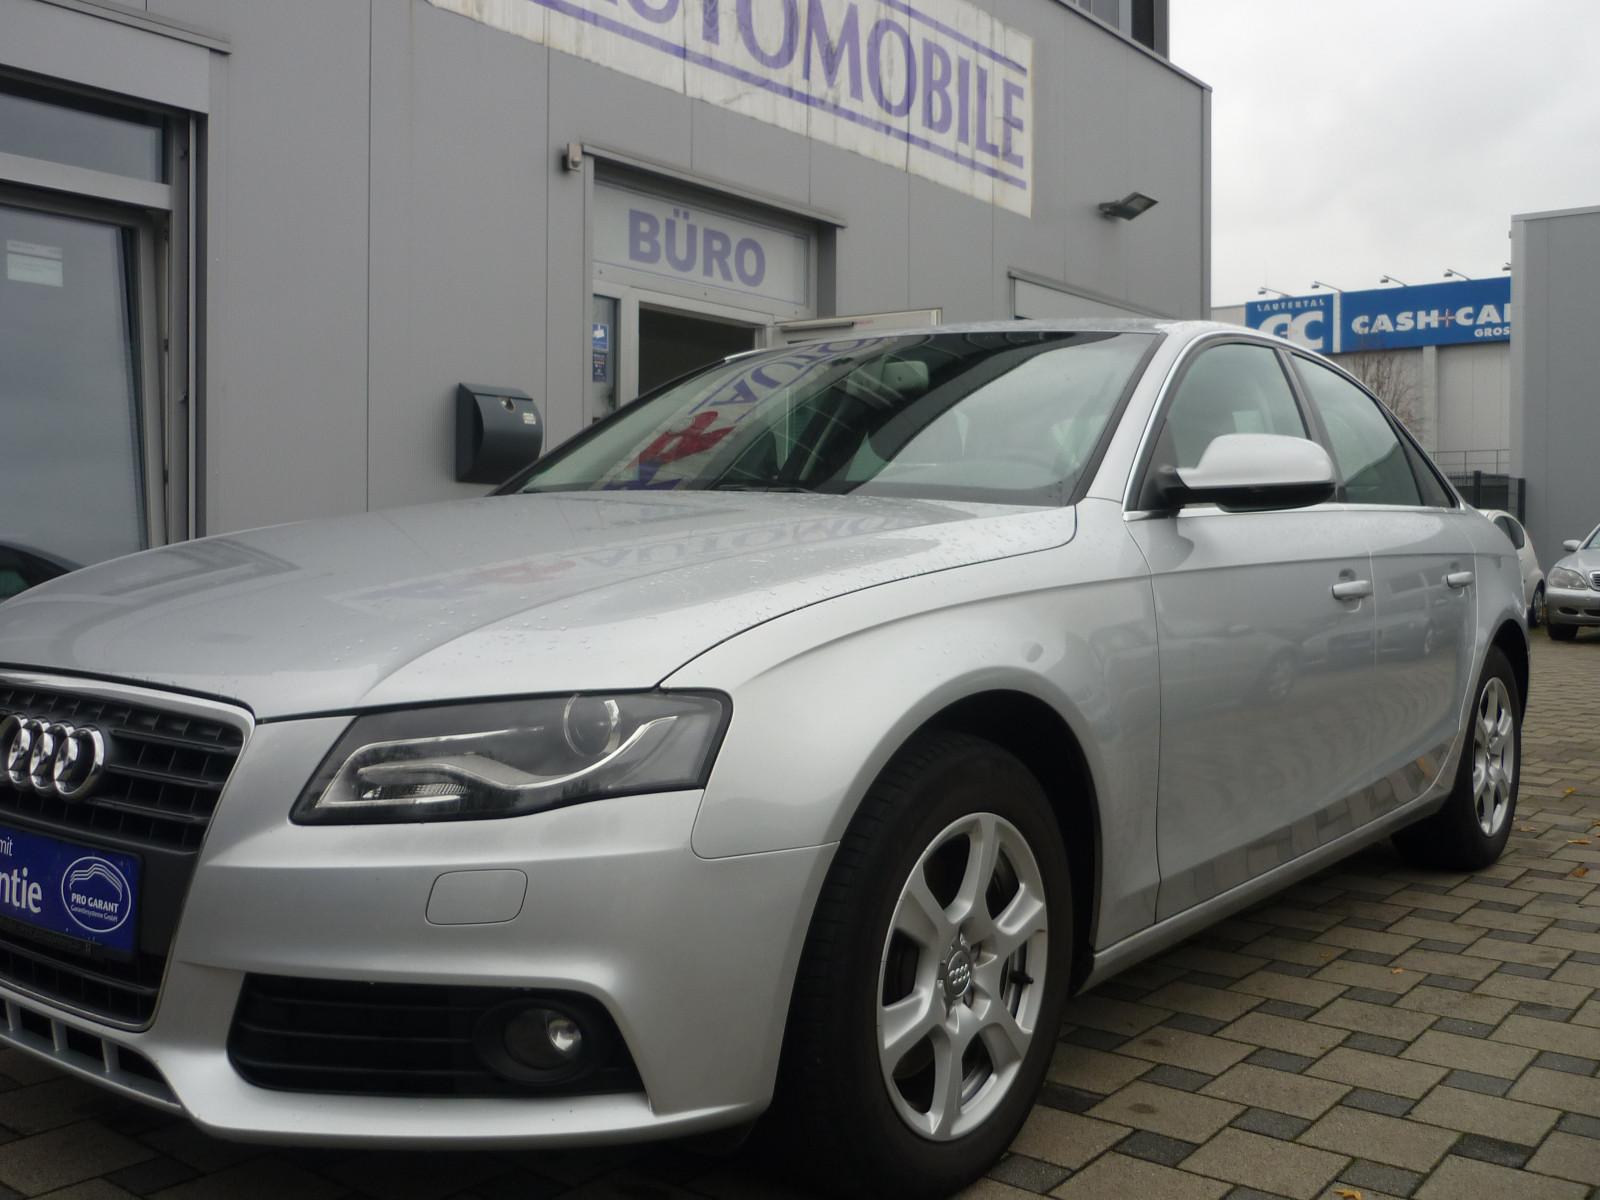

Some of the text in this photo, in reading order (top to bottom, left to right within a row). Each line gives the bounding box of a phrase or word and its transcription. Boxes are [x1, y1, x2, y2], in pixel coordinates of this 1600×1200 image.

[628, 208, 766, 287] BÜRO
[1351, 303, 1511, 335] CASH+CA
[71, 892, 119, 913] PRO GARANT
